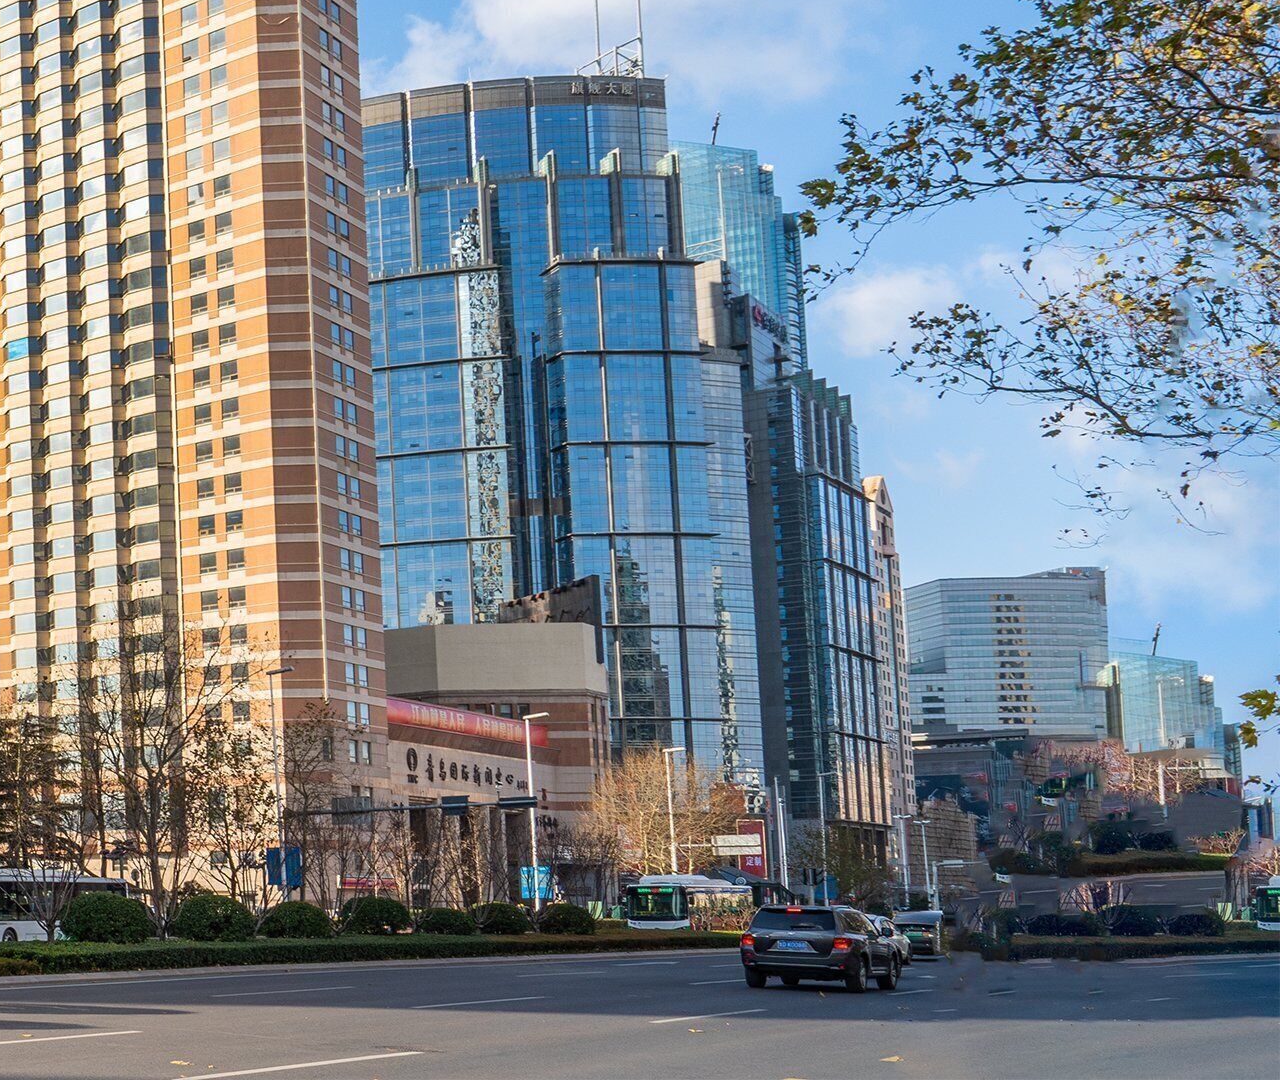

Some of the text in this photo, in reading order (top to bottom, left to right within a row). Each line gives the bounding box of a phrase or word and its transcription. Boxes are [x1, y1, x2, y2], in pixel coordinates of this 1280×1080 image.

[570, 82, 634, 95] 旗舰大厦
[425, 753, 514, 787] 青岛国际新闻中心
